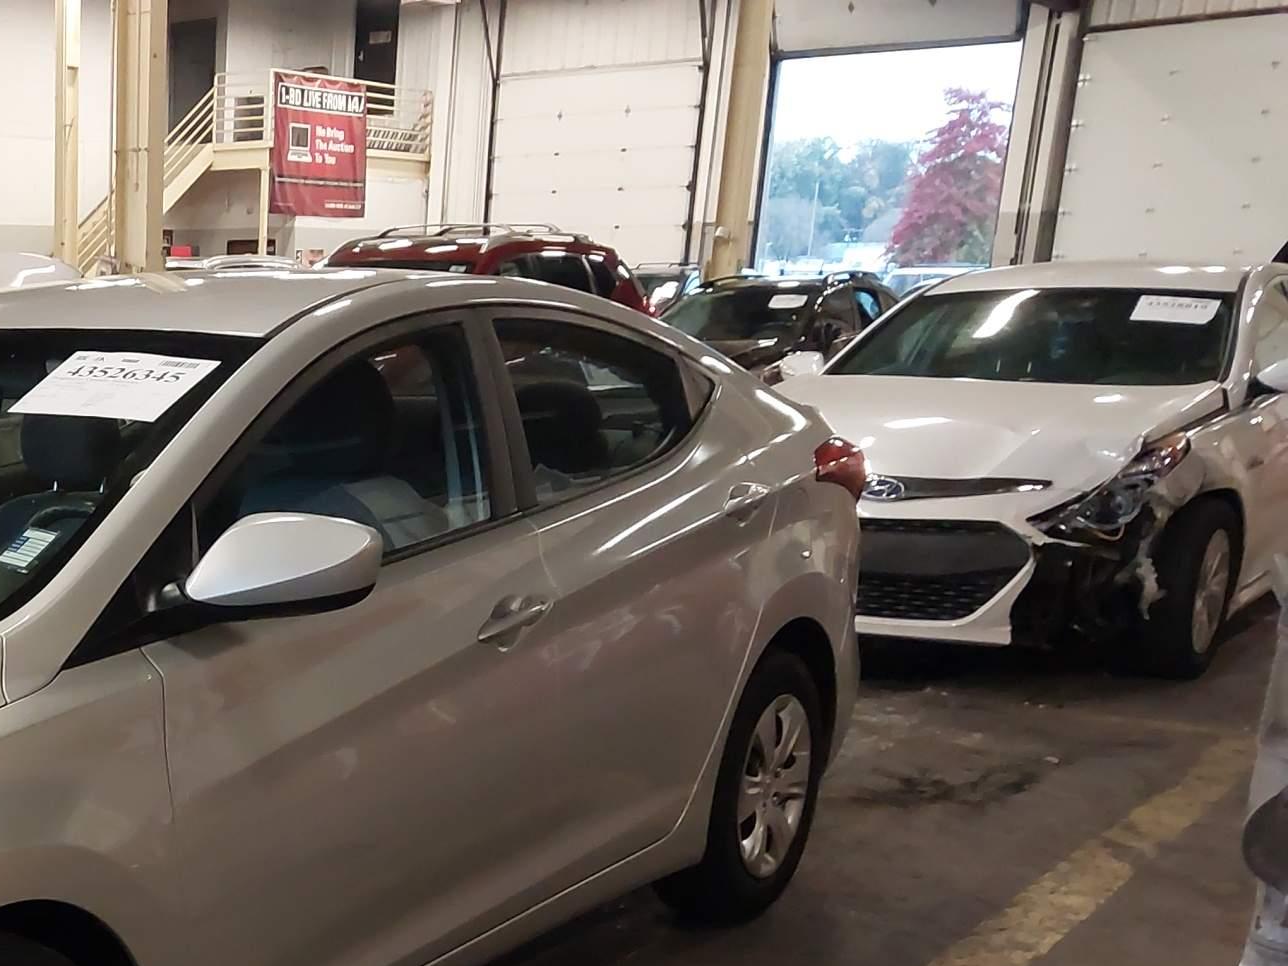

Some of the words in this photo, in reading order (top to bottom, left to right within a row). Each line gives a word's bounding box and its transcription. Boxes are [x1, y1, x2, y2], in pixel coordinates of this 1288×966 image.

[303, 89, 322, 109] LIVE
[322, 92, 346, 111] FROM
[326, 127, 345, 141] Bring
[315, 139, 327, 150] The
[328, 140, 355, 153] Auction
[315, 153, 323, 164] To
[324, 153, 337, 165] You
[67, 364, 188, 384] 43526345
